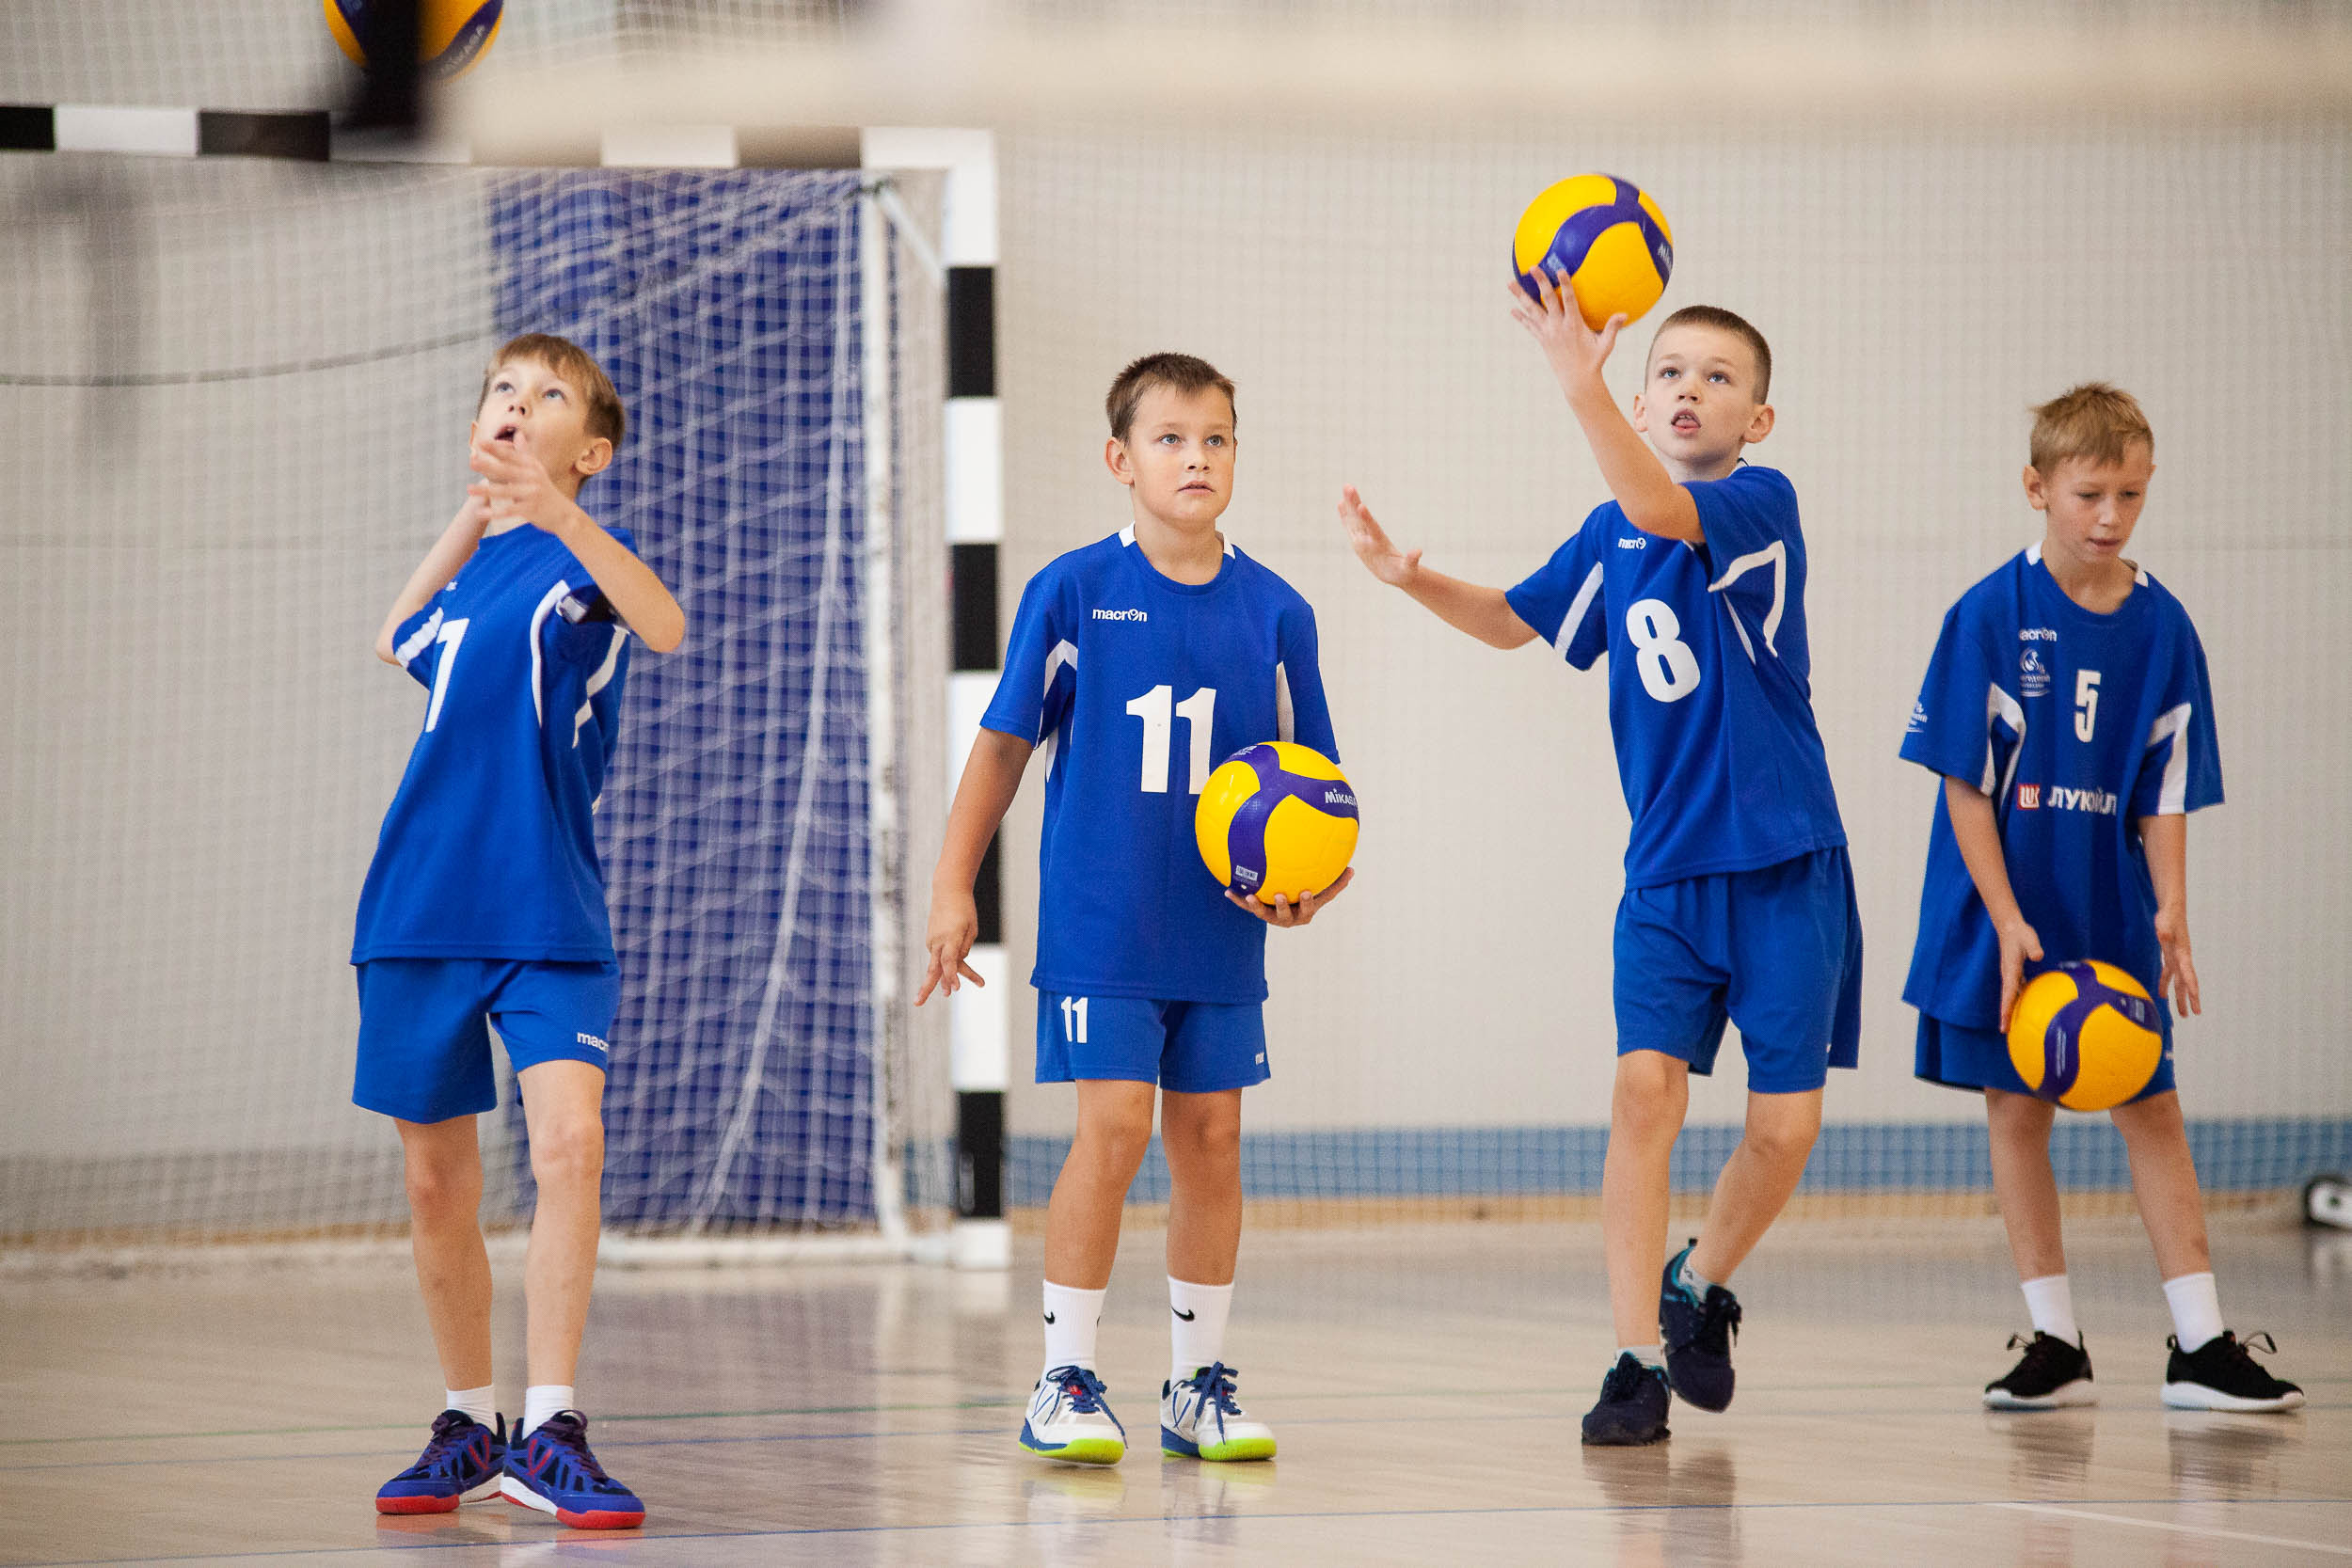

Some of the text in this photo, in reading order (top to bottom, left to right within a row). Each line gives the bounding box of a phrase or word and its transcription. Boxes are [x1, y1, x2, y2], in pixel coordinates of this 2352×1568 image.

[1091, 608, 1149, 623] macron
[2019, 627, 2058, 642] acron
[1625, 598, 1701, 704] 8
[2074, 669, 2102, 743] 5
[1125, 684, 1217, 795] 11
[1060, 995, 1089, 1044] 11
